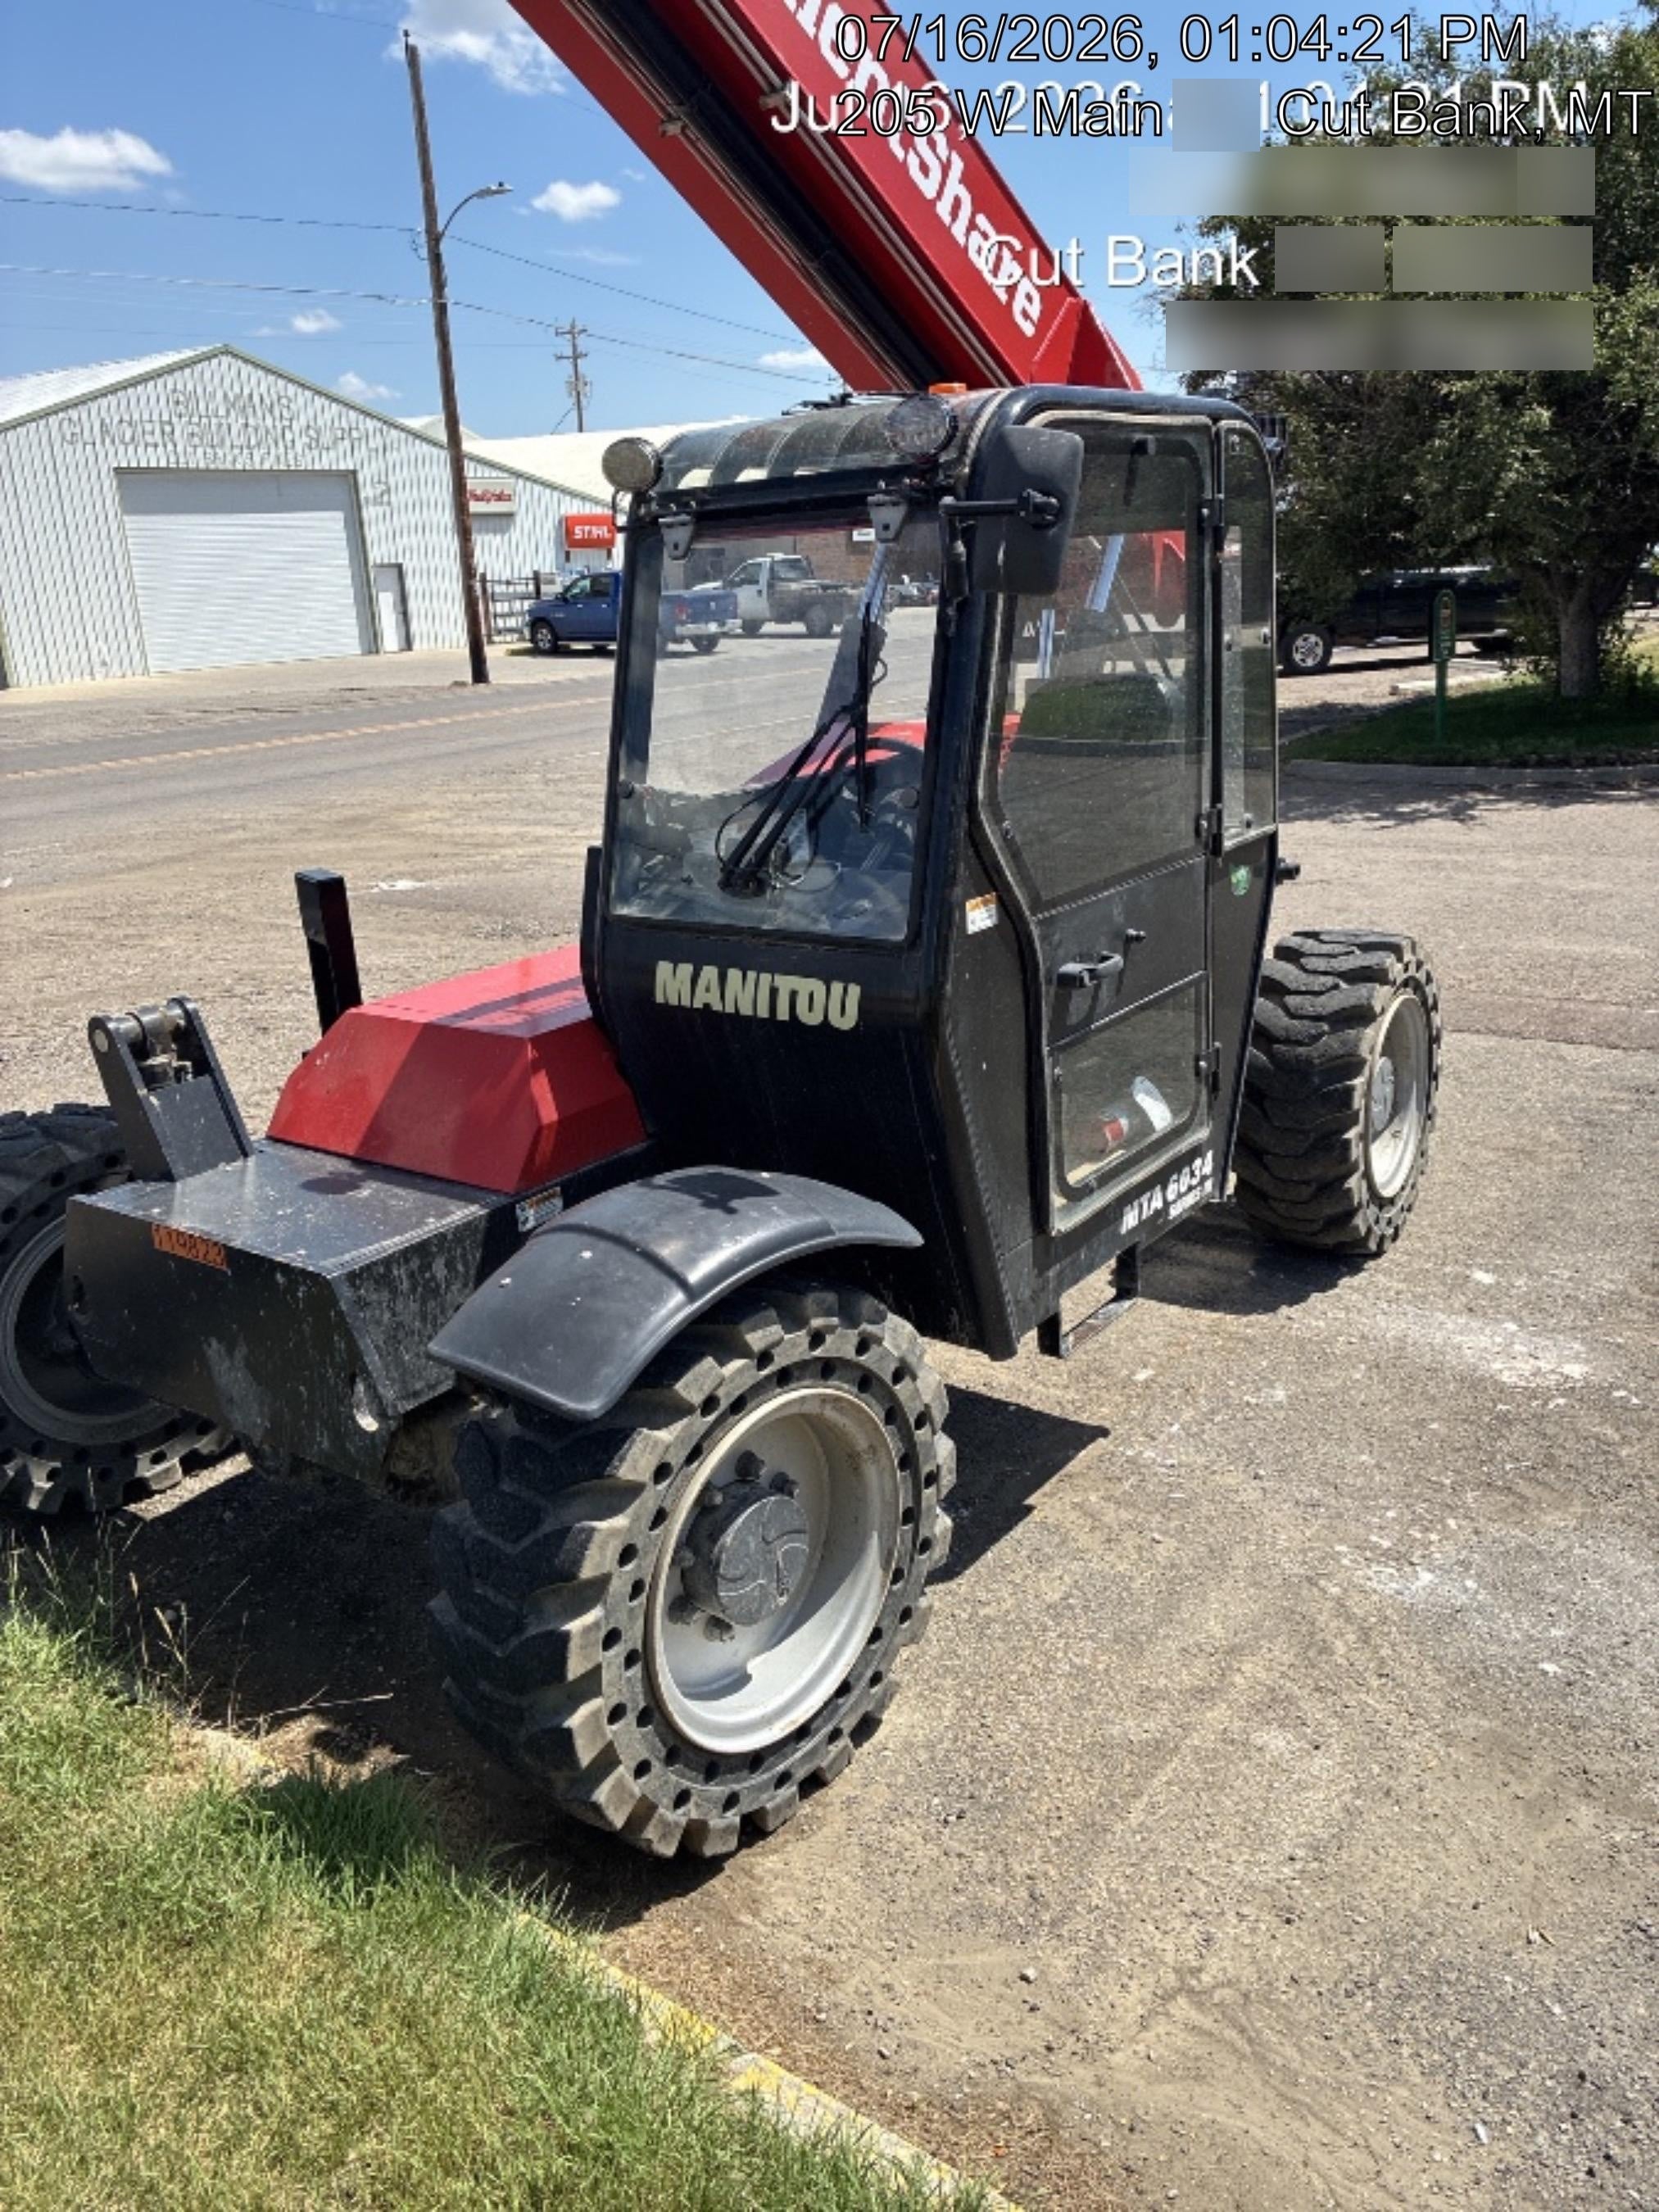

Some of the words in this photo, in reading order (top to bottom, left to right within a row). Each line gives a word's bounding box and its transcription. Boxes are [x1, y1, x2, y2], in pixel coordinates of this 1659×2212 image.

[573, 525, 611, 539] STIHL
[655, 959, 861, 1031] MANITOU
[1119, 1183, 1163, 1235] MTA
[1165, 1149, 1213, 1203] 6034
